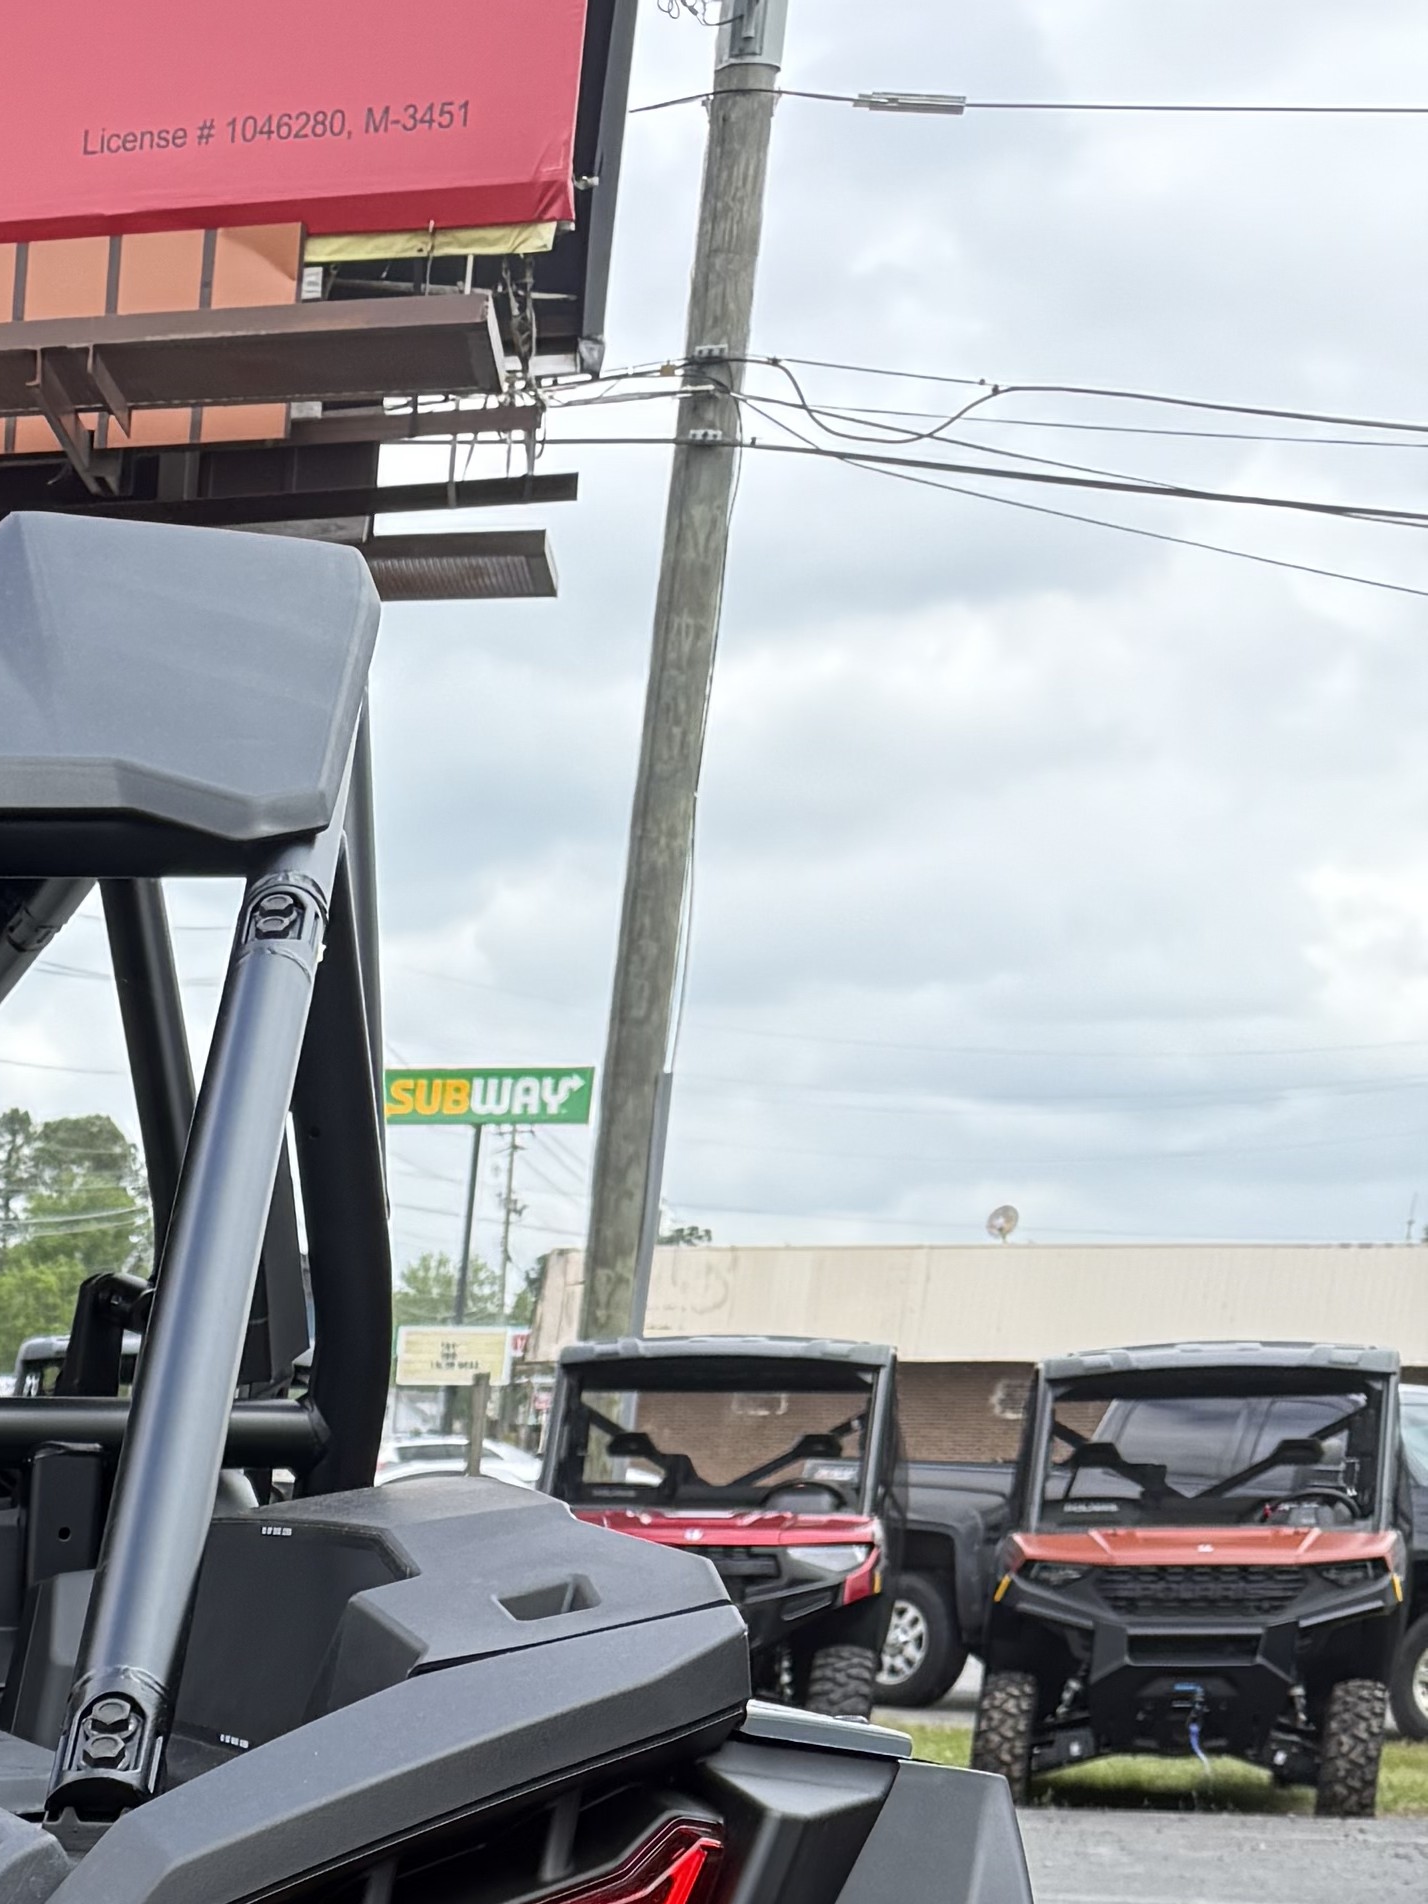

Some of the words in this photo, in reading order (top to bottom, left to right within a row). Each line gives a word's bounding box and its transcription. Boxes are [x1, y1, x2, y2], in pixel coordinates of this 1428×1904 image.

[82, 126, 188, 156] License
[196, 118, 216, 146] #
[226, 108, 354, 144] 1046280,
[363, 99, 471, 135] M-3451
[385, 1074, 586, 1118] SUBWAY
